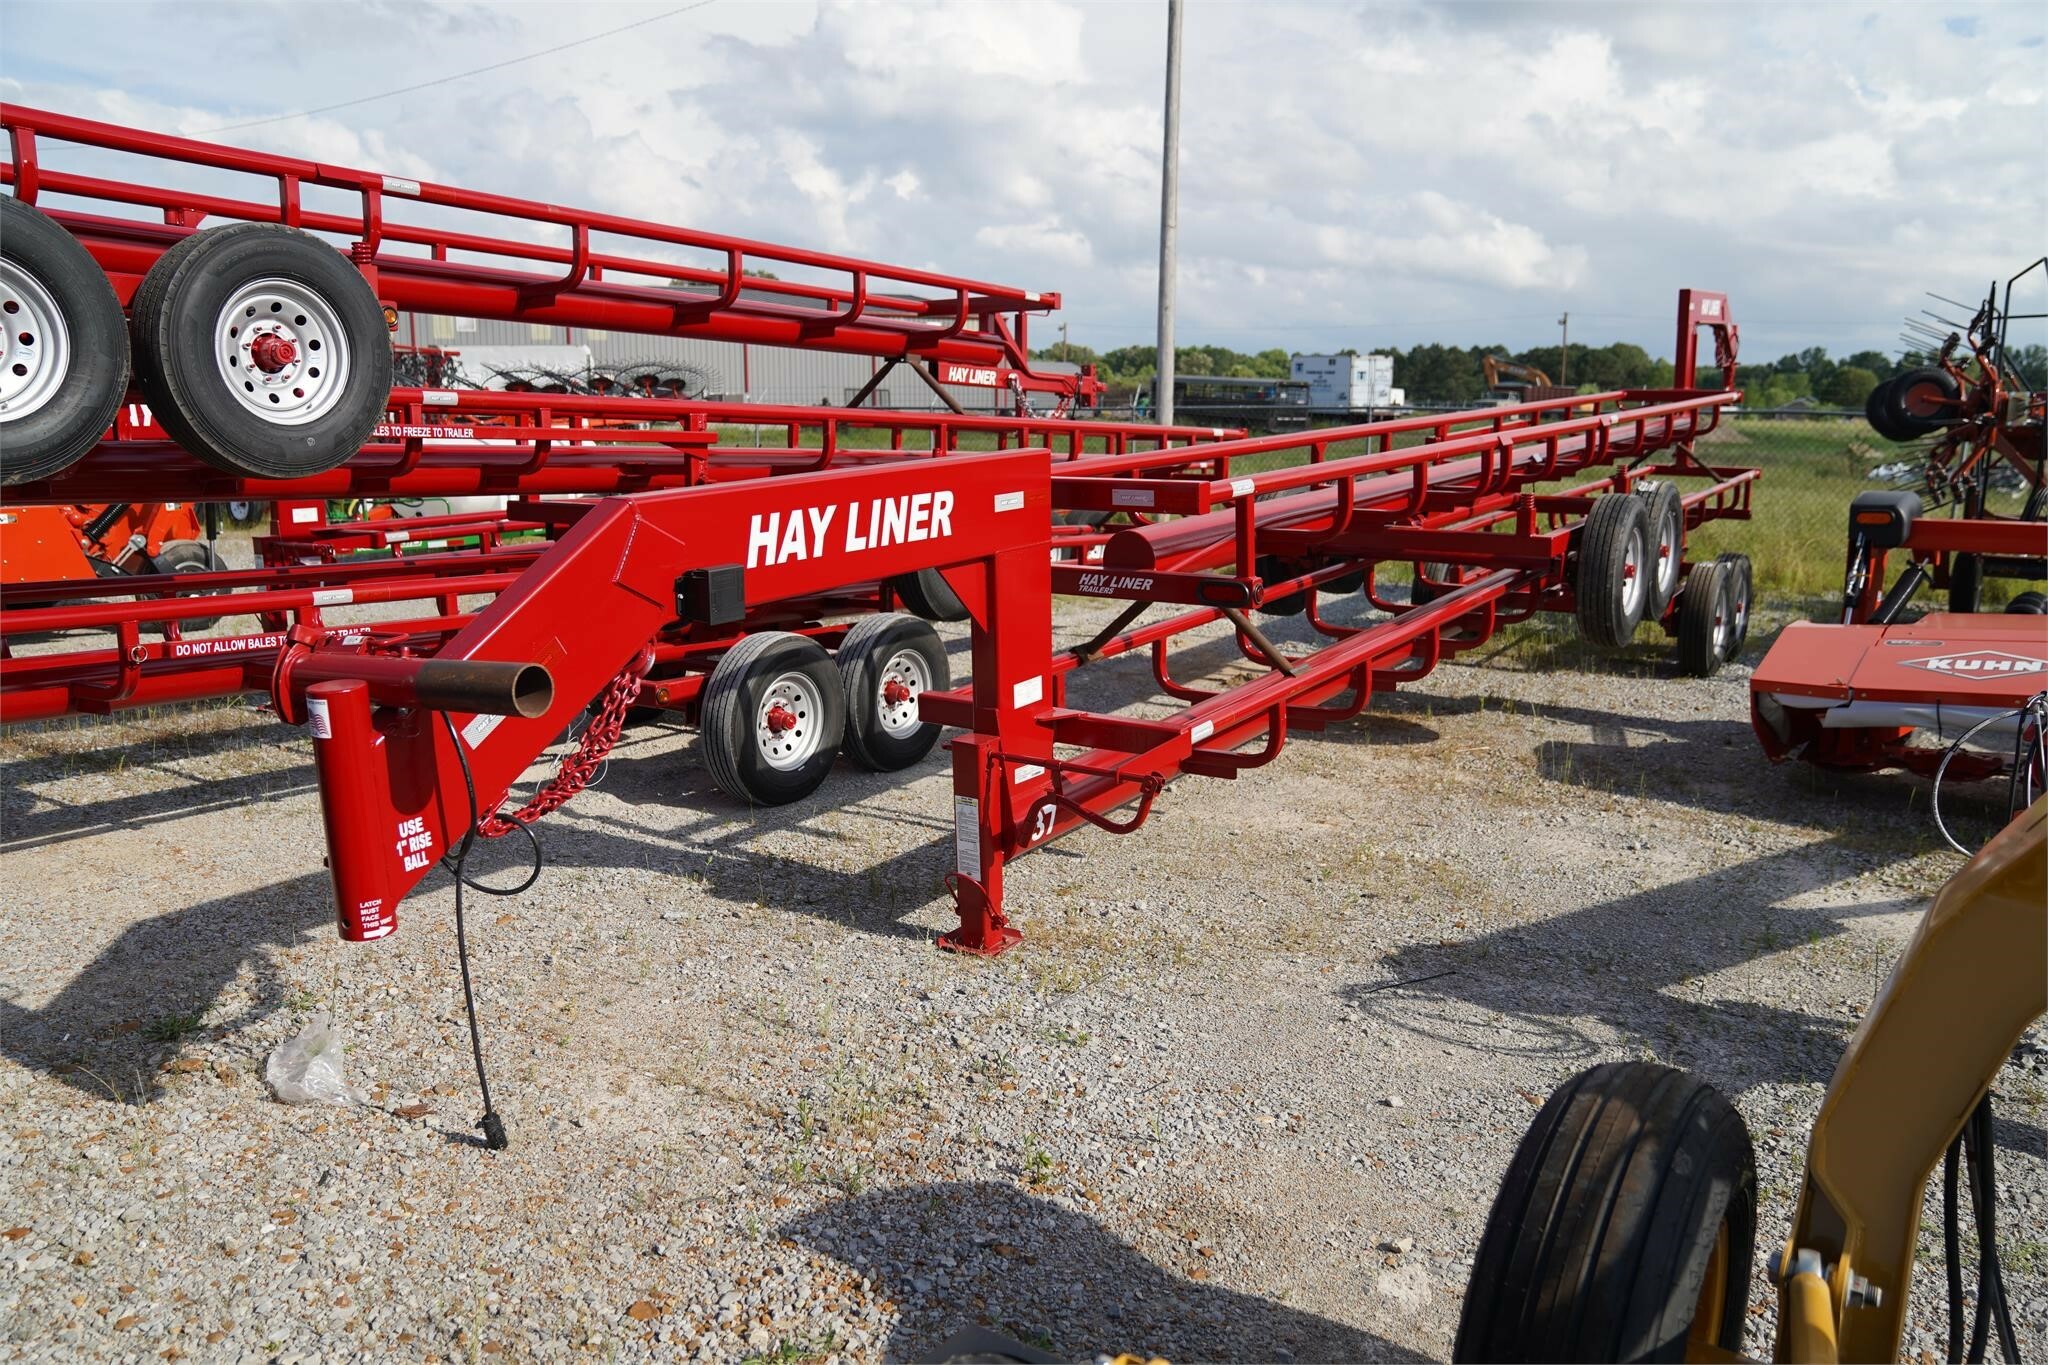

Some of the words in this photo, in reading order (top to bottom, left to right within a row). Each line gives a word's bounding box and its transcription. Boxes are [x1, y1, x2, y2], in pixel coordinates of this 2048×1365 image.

[948, 366, 969, 382] HAY
[969, 369, 997, 386] LINER
[391, 426, 402, 437] TO
[403, 427, 432, 438] FREEZE
[432, 428, 443, 438] TO
[444, 428, 474, 438] TRAILER
[746, 504, 837, 569] HAY
[845, 490, 954, 553] LINER
[1078, 573, 1110, 587] HAY
[1110, 576, 1154, 591] LINER
[1078, 584, 1115, 595] TRAILERS
[176, 645, 190, 656] DO
[192, 643, 212, 655] NOT
[213, 640, 248, 653] ALLOW
[248, 637, 276, 650] BALES
[1926, 658, 2042, 672] KUHN
[398, 816, 425, 838] USE
[1031, 803, 1057, 841] 37
[408, 831, 433, 853] RISE
[403, 851, 430, 872] BALL
[360, 899, 382, 908] LATCH
[361, 907, 380, 915] MUST
[361, 914, 380, 922] FACE
[362, 920, 380, 929] THIS
[380, 915, 392, 926] WAY
